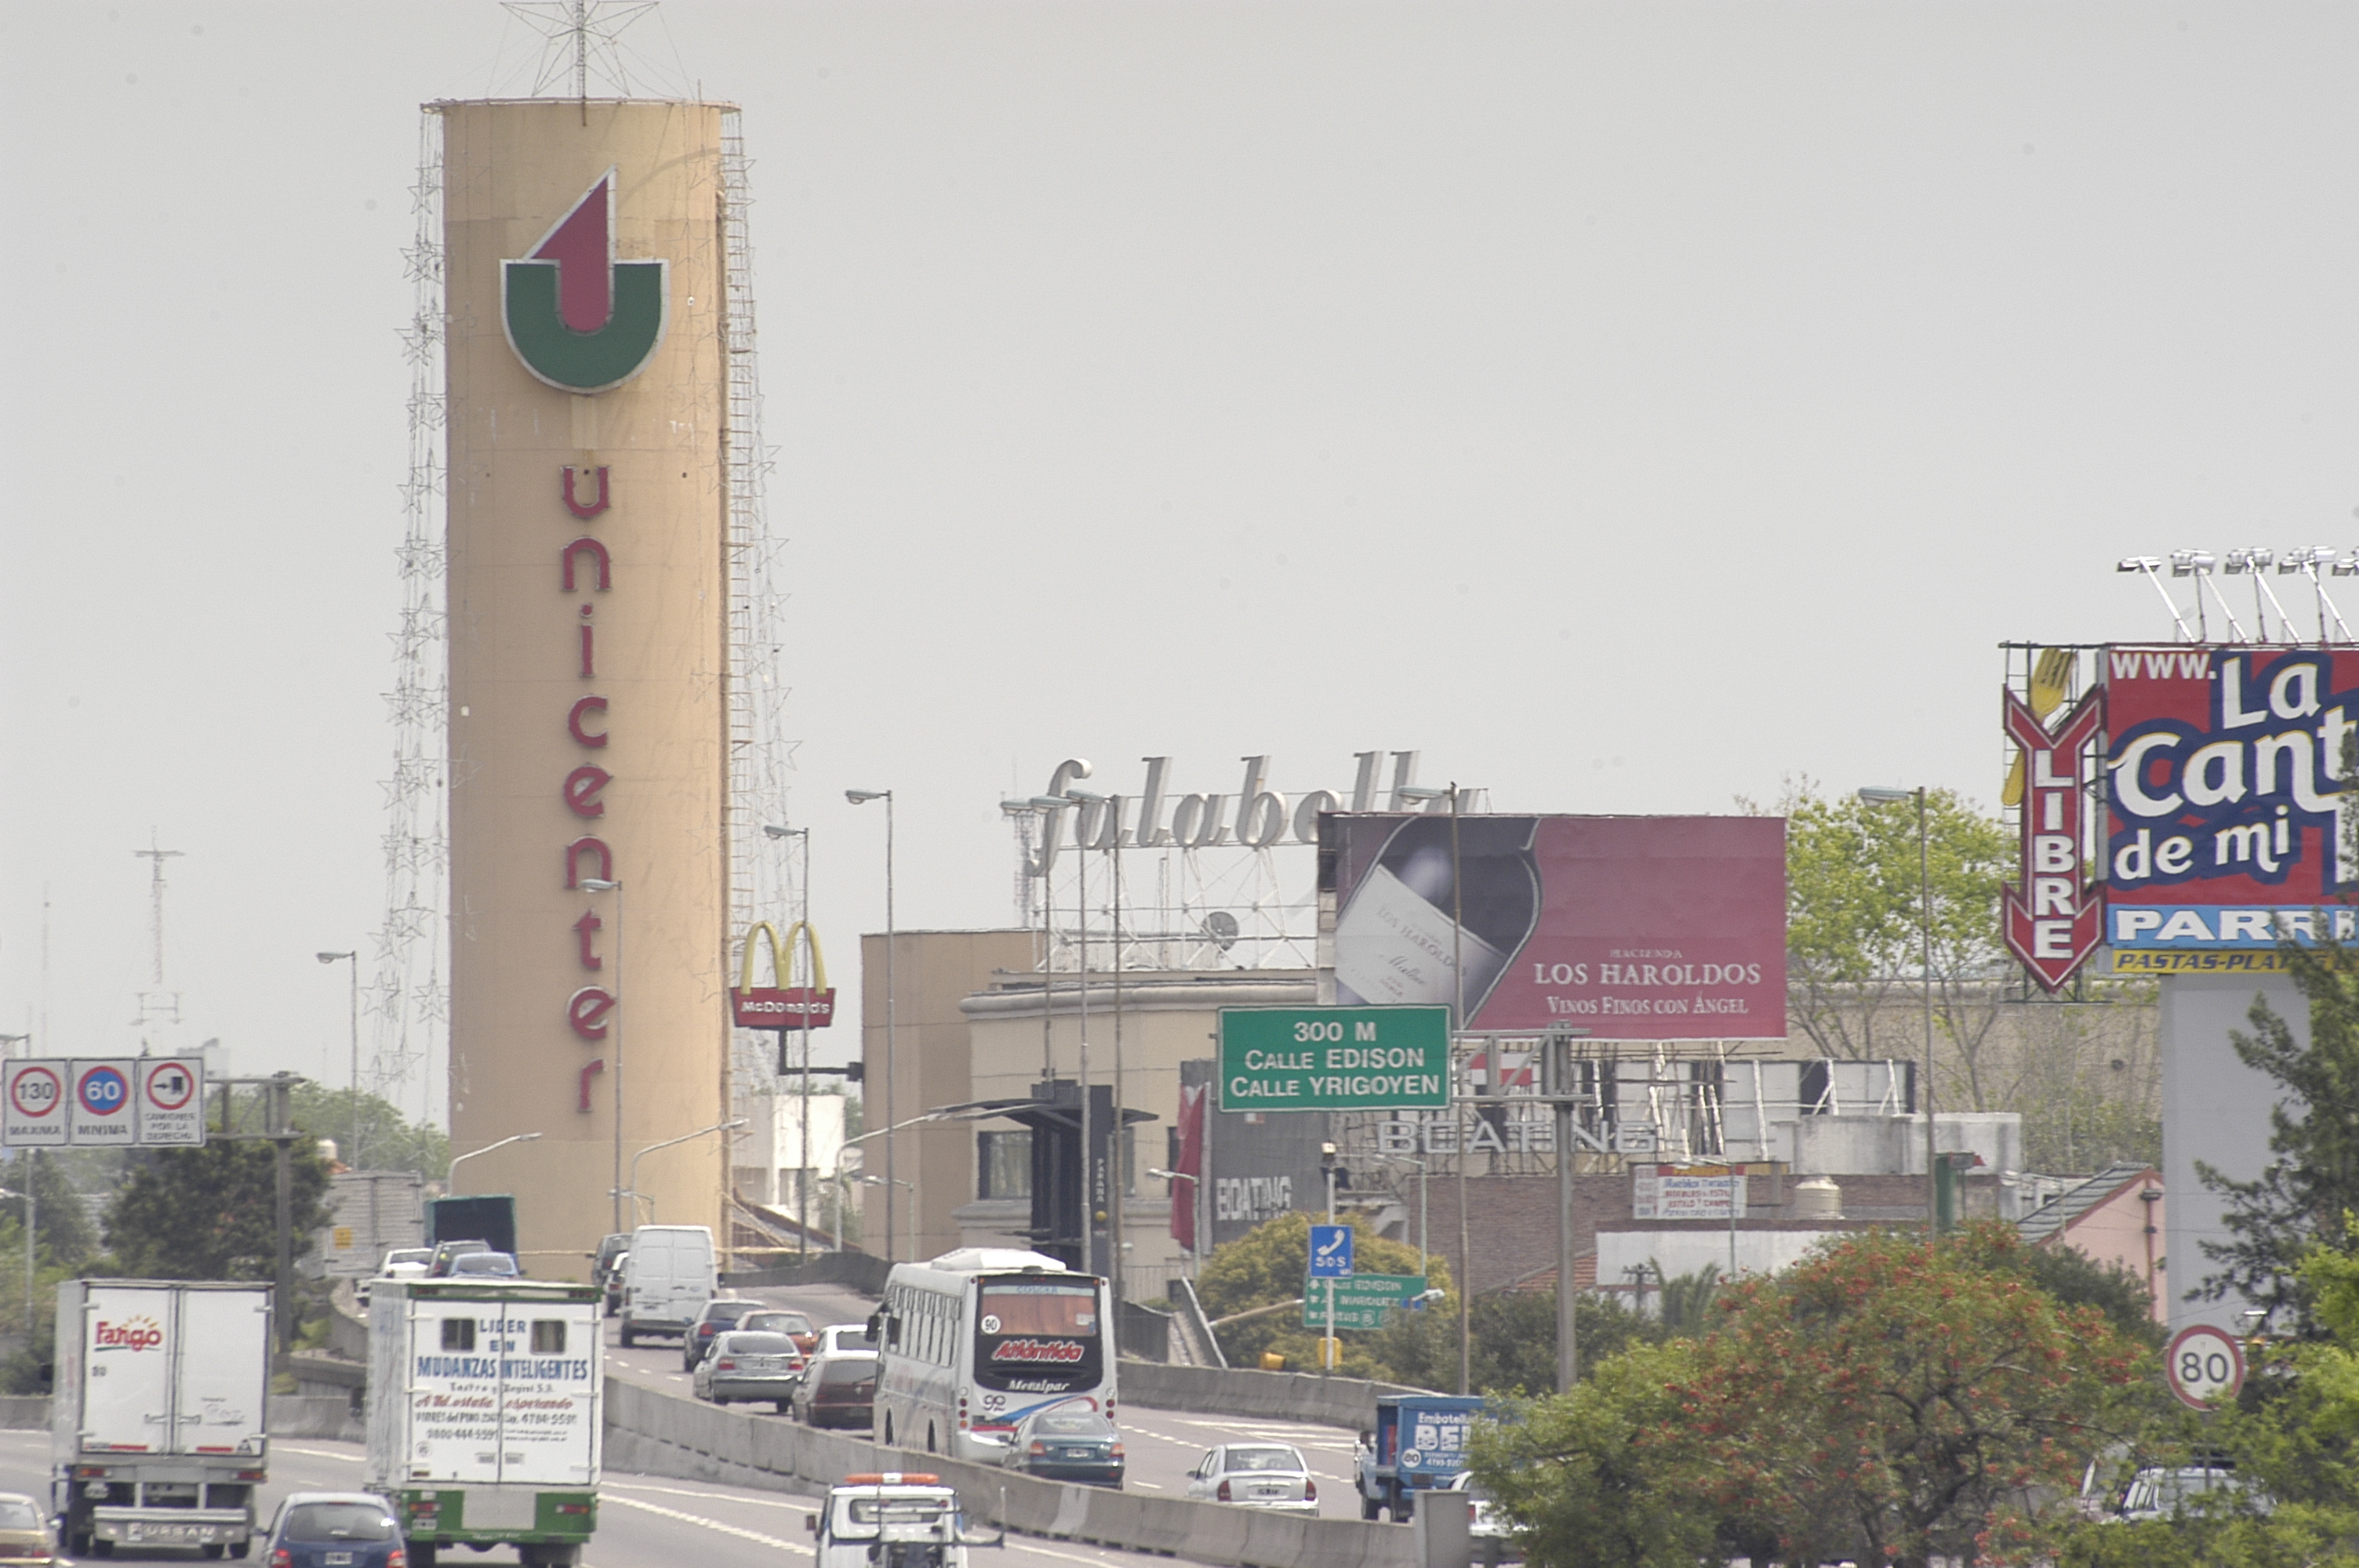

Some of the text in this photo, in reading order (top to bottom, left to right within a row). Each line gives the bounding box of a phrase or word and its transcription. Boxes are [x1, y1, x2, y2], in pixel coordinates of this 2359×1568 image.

[2223, 657, 2321, 729] La
[560, 464, 613, 1112] unicenter
[2115, 829, 2194, 880] de
[2215, 805, 2290, 873] mi
[2034, 750, 2077, 959] LIBRE
[1401, 926, 1467, 977] HAROLDS
[1610, 949, 1683, 958] HACIENDA
[1533, 963, 1761, 985] LOS HAROLDOS
[741, 1001, 831, 1014] McDonad's
[1294, 1022, 1376, 1042] 300 M
[1245, 1047, 1425, 1070] CALLE EDISON
[19, 1083, 55, 1099] 130
[85, 1081, 120, 1100] 60
[1230, 1075, 1440, 1097] CALLE YRIGOYEN
[1315, 1256, 1346, 1267] SOS
[985, 1319, 997, 1330] 90
[416, 1356, 587, 1380] MUDANZAS INTELIGENTES
[2181, 1352, 2229, 1383] 80
